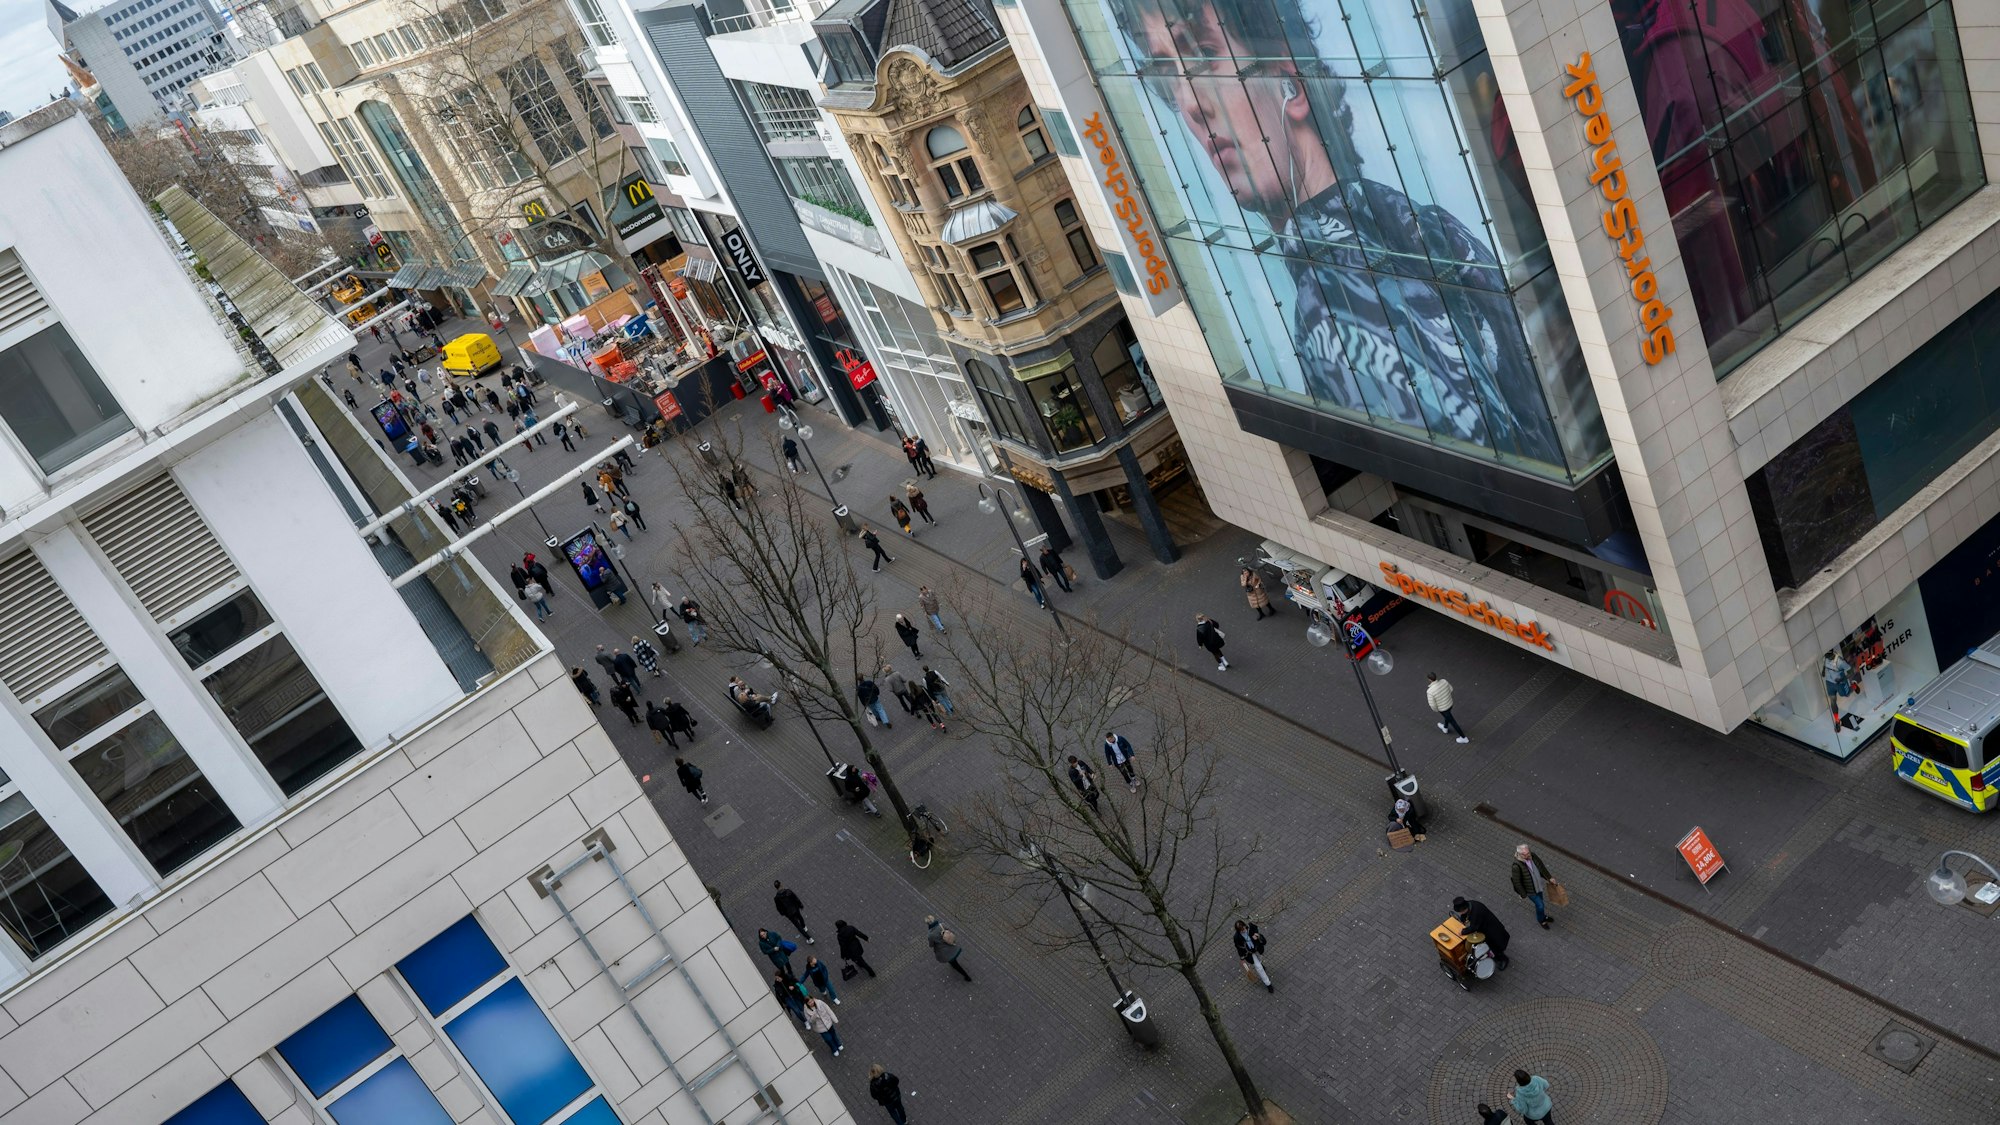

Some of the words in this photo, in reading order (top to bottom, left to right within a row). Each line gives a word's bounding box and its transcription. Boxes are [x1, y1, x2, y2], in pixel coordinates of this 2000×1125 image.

[620, 212, 656, 236] McDonald's
[1083, 111, 1170, 296] SportScheck
[1562, 51, 1676, 366] SportScheck
[544, 231, 570, 249] C&A
[727, 233, 761, 281] ONLY
[1378, 560, 1557, 653] SportScheck
[1895, 747, 1921, 764] POLIZEI
